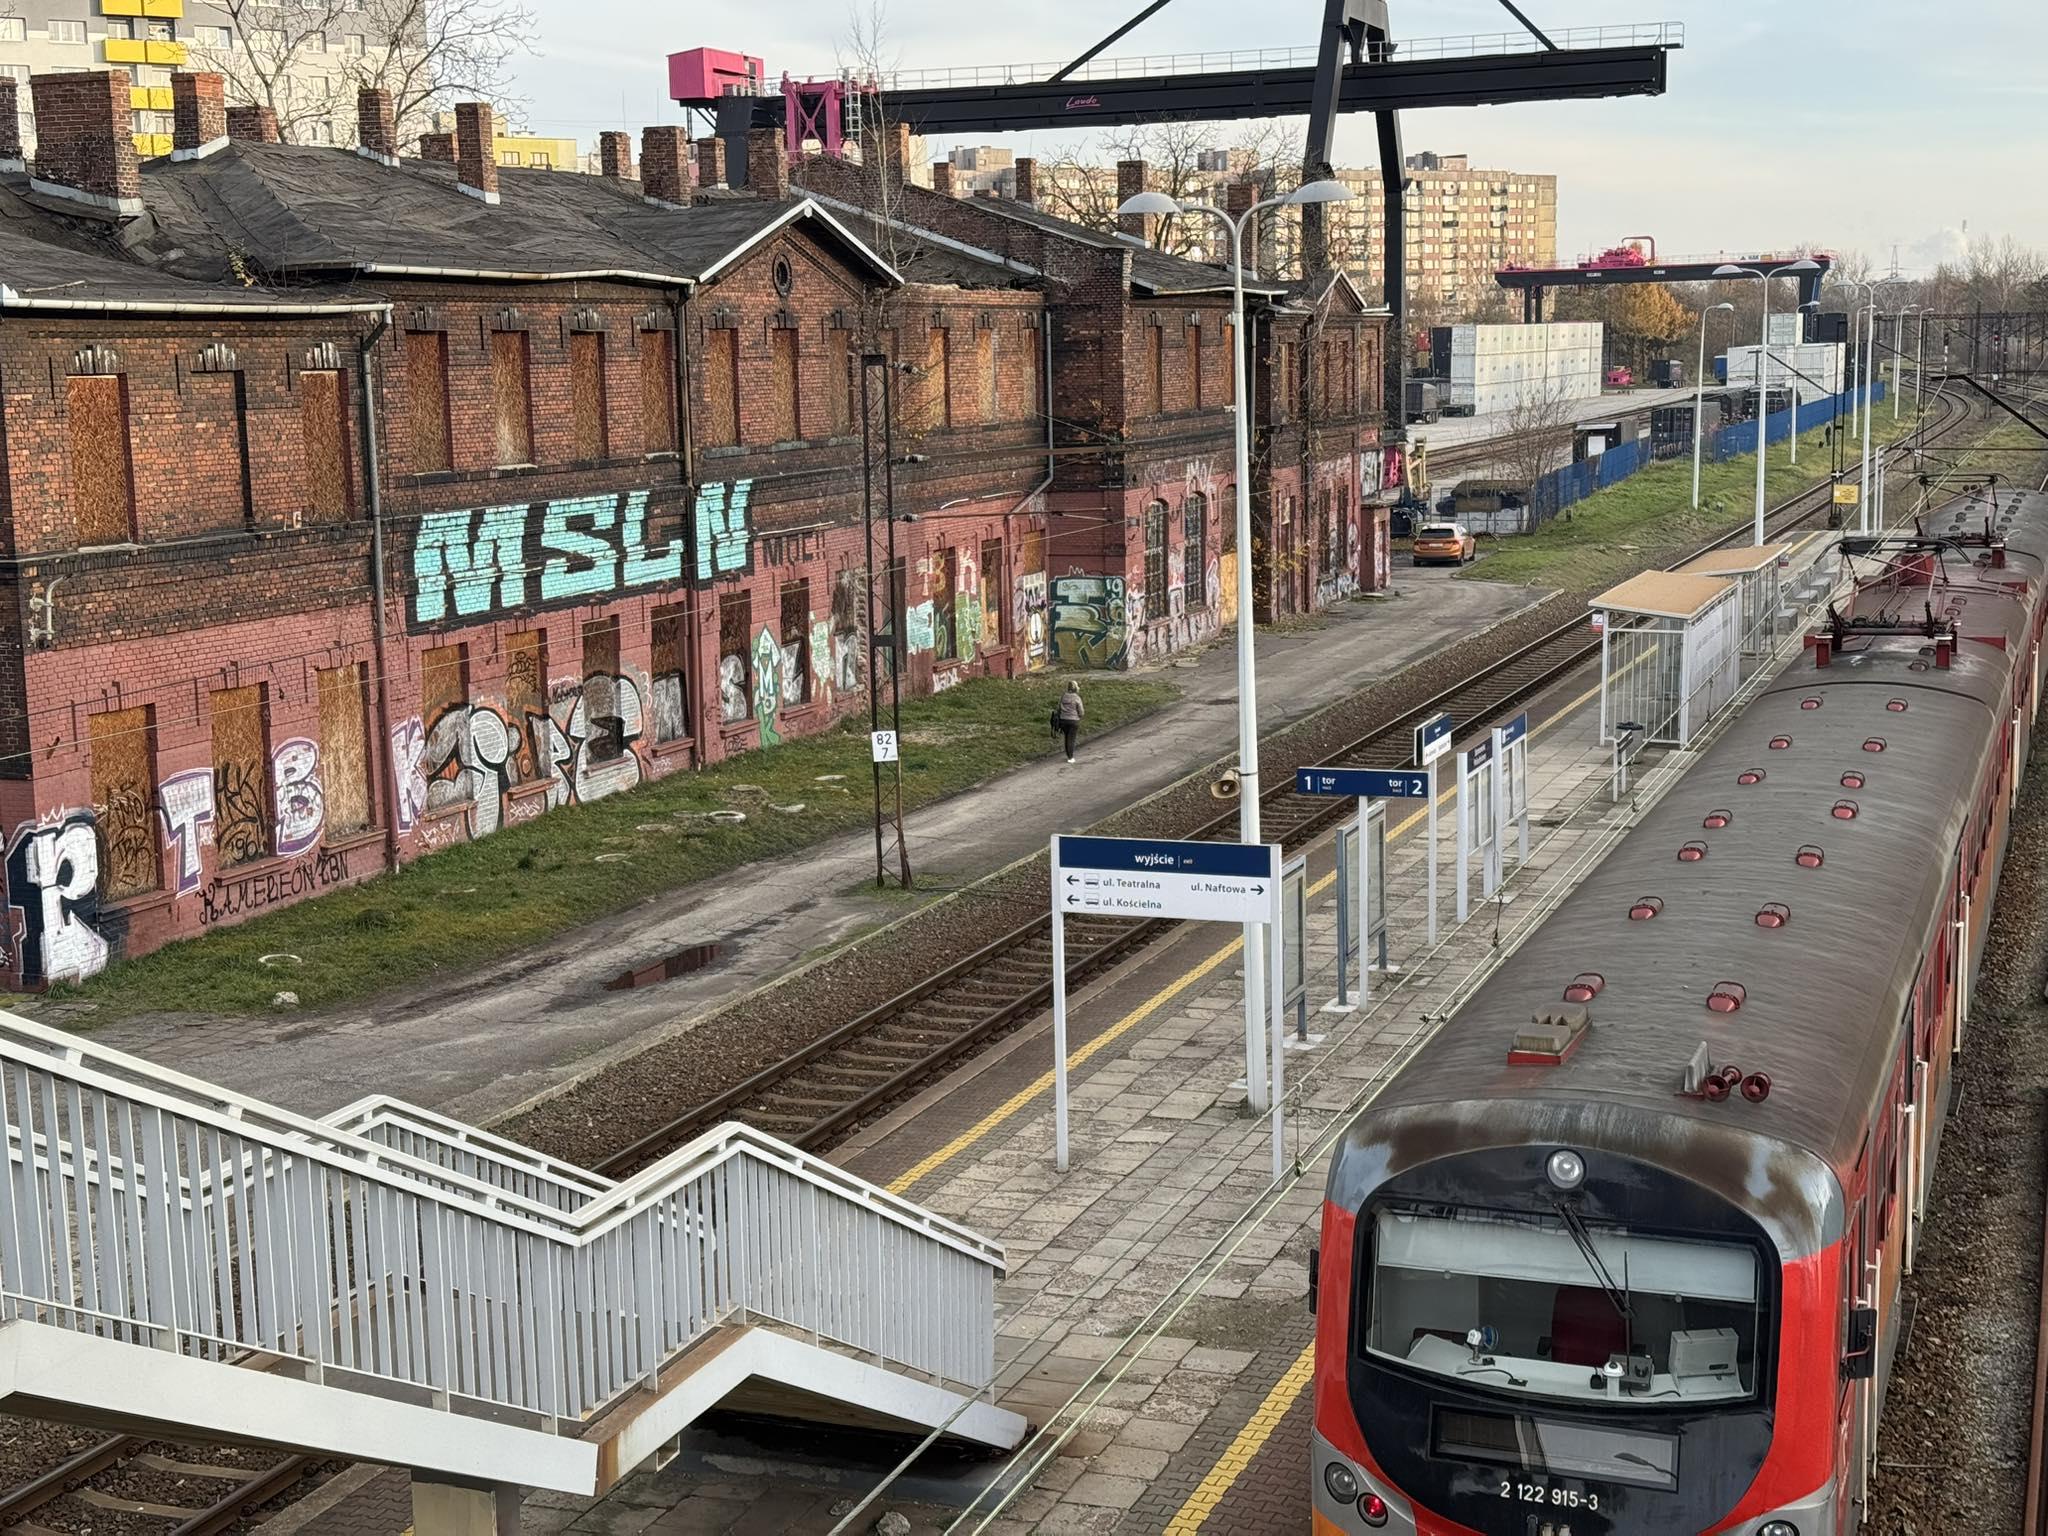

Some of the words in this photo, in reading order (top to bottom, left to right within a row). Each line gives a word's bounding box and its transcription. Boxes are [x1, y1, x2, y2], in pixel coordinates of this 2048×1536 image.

[876, 733, 892, 745] 82
[882, 747, 888, 759] 7
[1304, 776, 1311, 790] 1
[1322, 777, 1336, 785] tor
[1388, 779, 1403, 787] tor
[1411, 780, 1422, 795] 2
[1135, 853, 1174, 866] wyjście
[1103, 878, 1115, 887] ul.
[1116, 879, 1161, 889] Teatralna
[1191, 882, 1203, 891] ul.
[1205, 884, 1246, 893] Naftowa
[1103, 898, 1115, 906] ul.
[1116, 897, 1162, 909] Kościelna
[1500, 1481, 1511, 1498] 2
[1517, 1483, 1545, 1503] 122
[1551, 1488, 1598, 1510] 915-3
